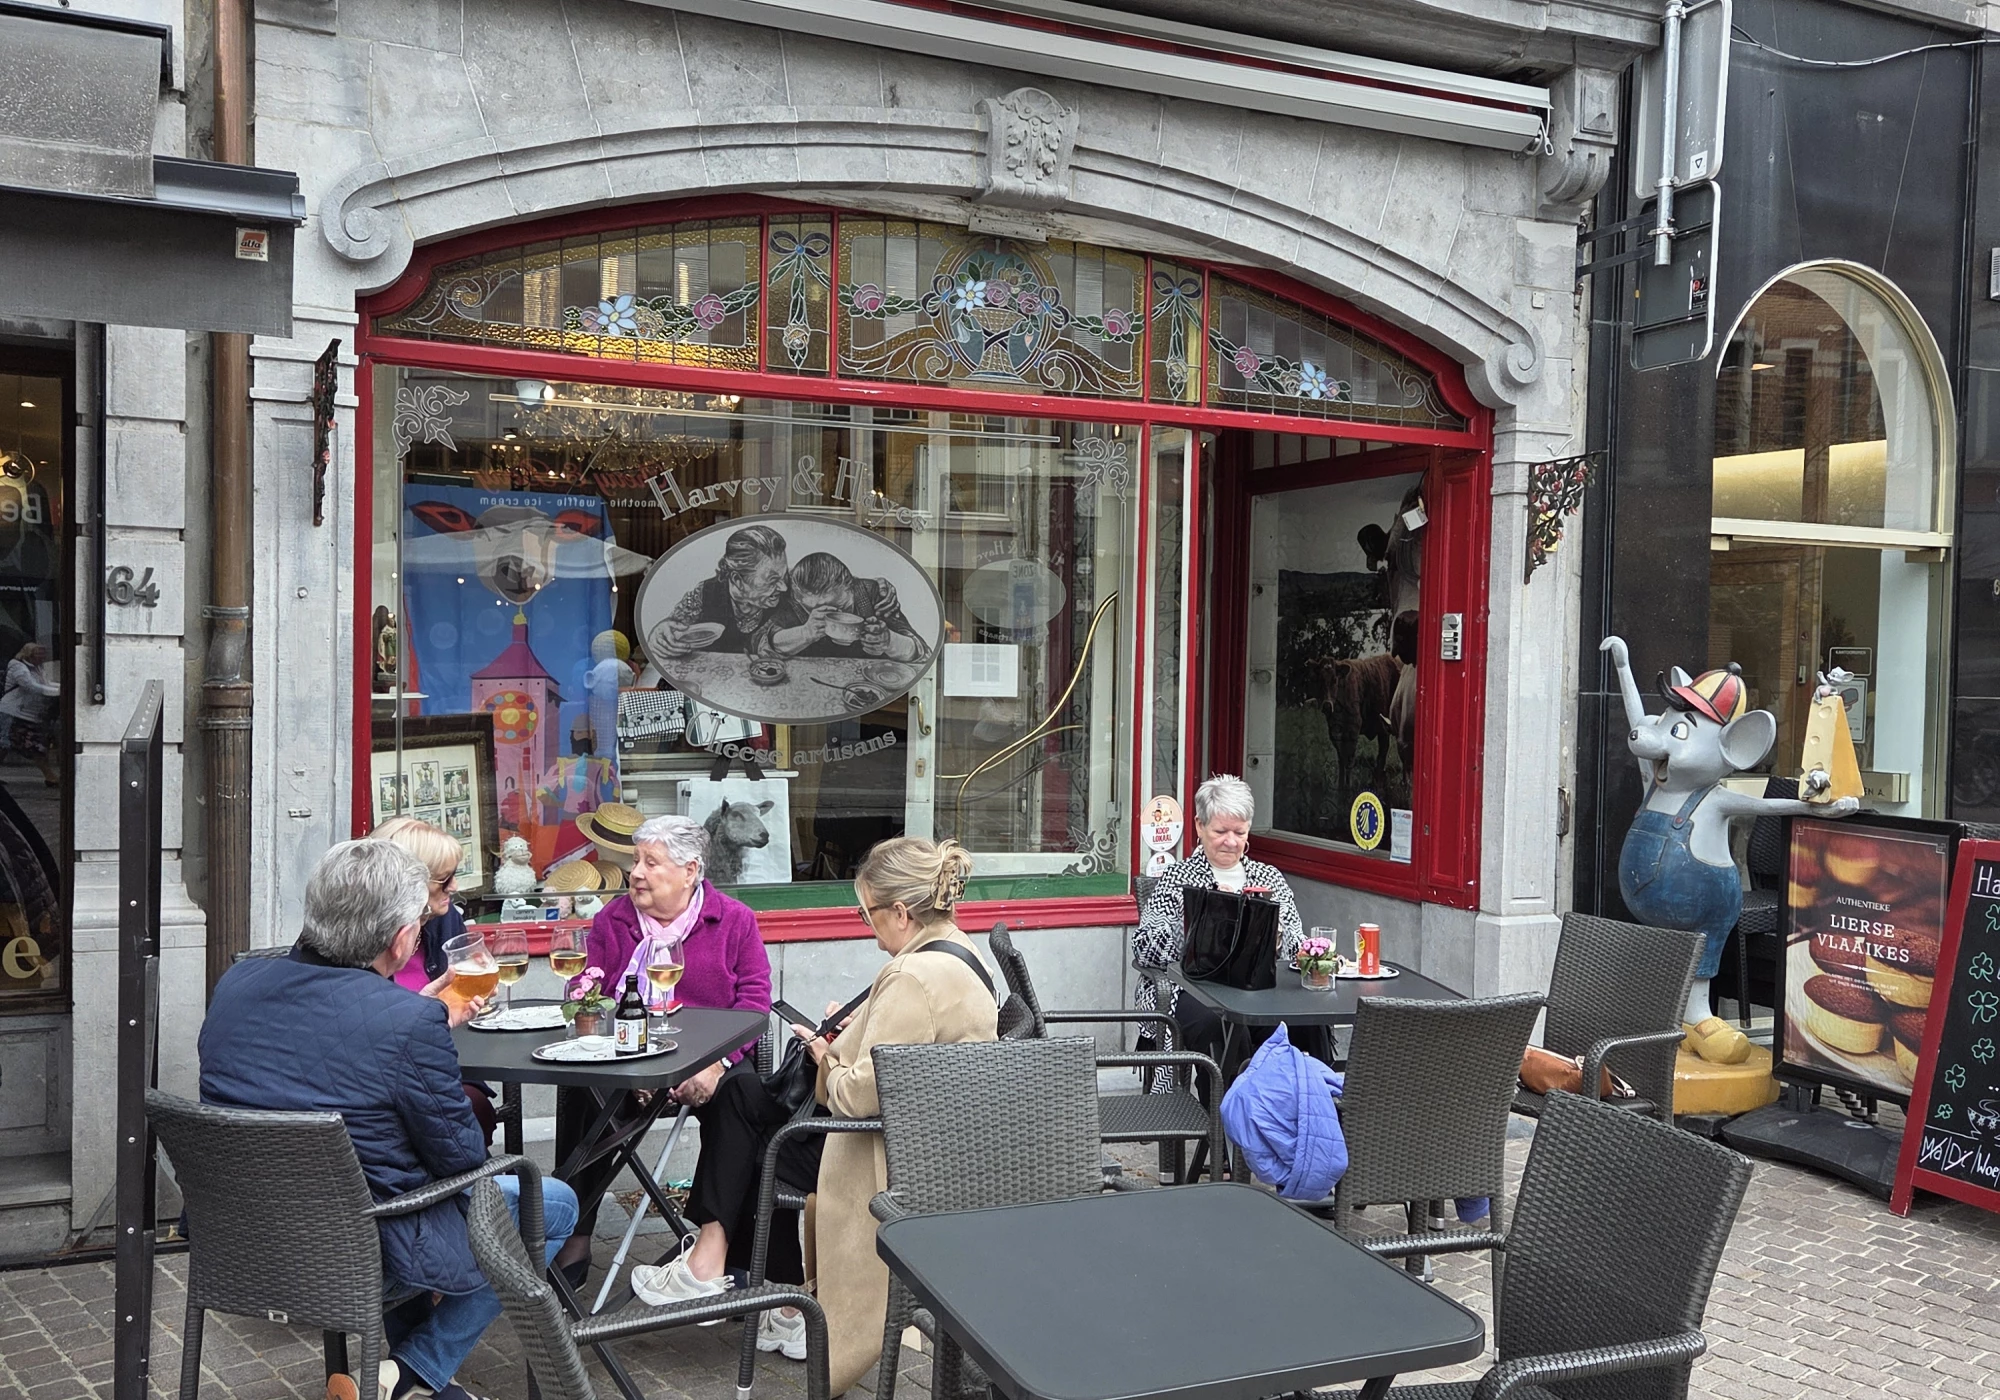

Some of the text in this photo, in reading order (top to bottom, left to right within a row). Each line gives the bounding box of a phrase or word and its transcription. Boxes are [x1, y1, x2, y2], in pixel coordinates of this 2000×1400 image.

[240, 239, 261, 248] alfa
[645, 454, 928, 534] Harvey & Hayes
[107, 566, 160, 608] 64
[685, 711, 898, 766] Cheese artisans
[1836, 896, 1891, 912] AUTHENTIEKE
[1830, 914, 1895, 939] LIERSE
[1816, 932, 1910, 963] VLAAIKES
